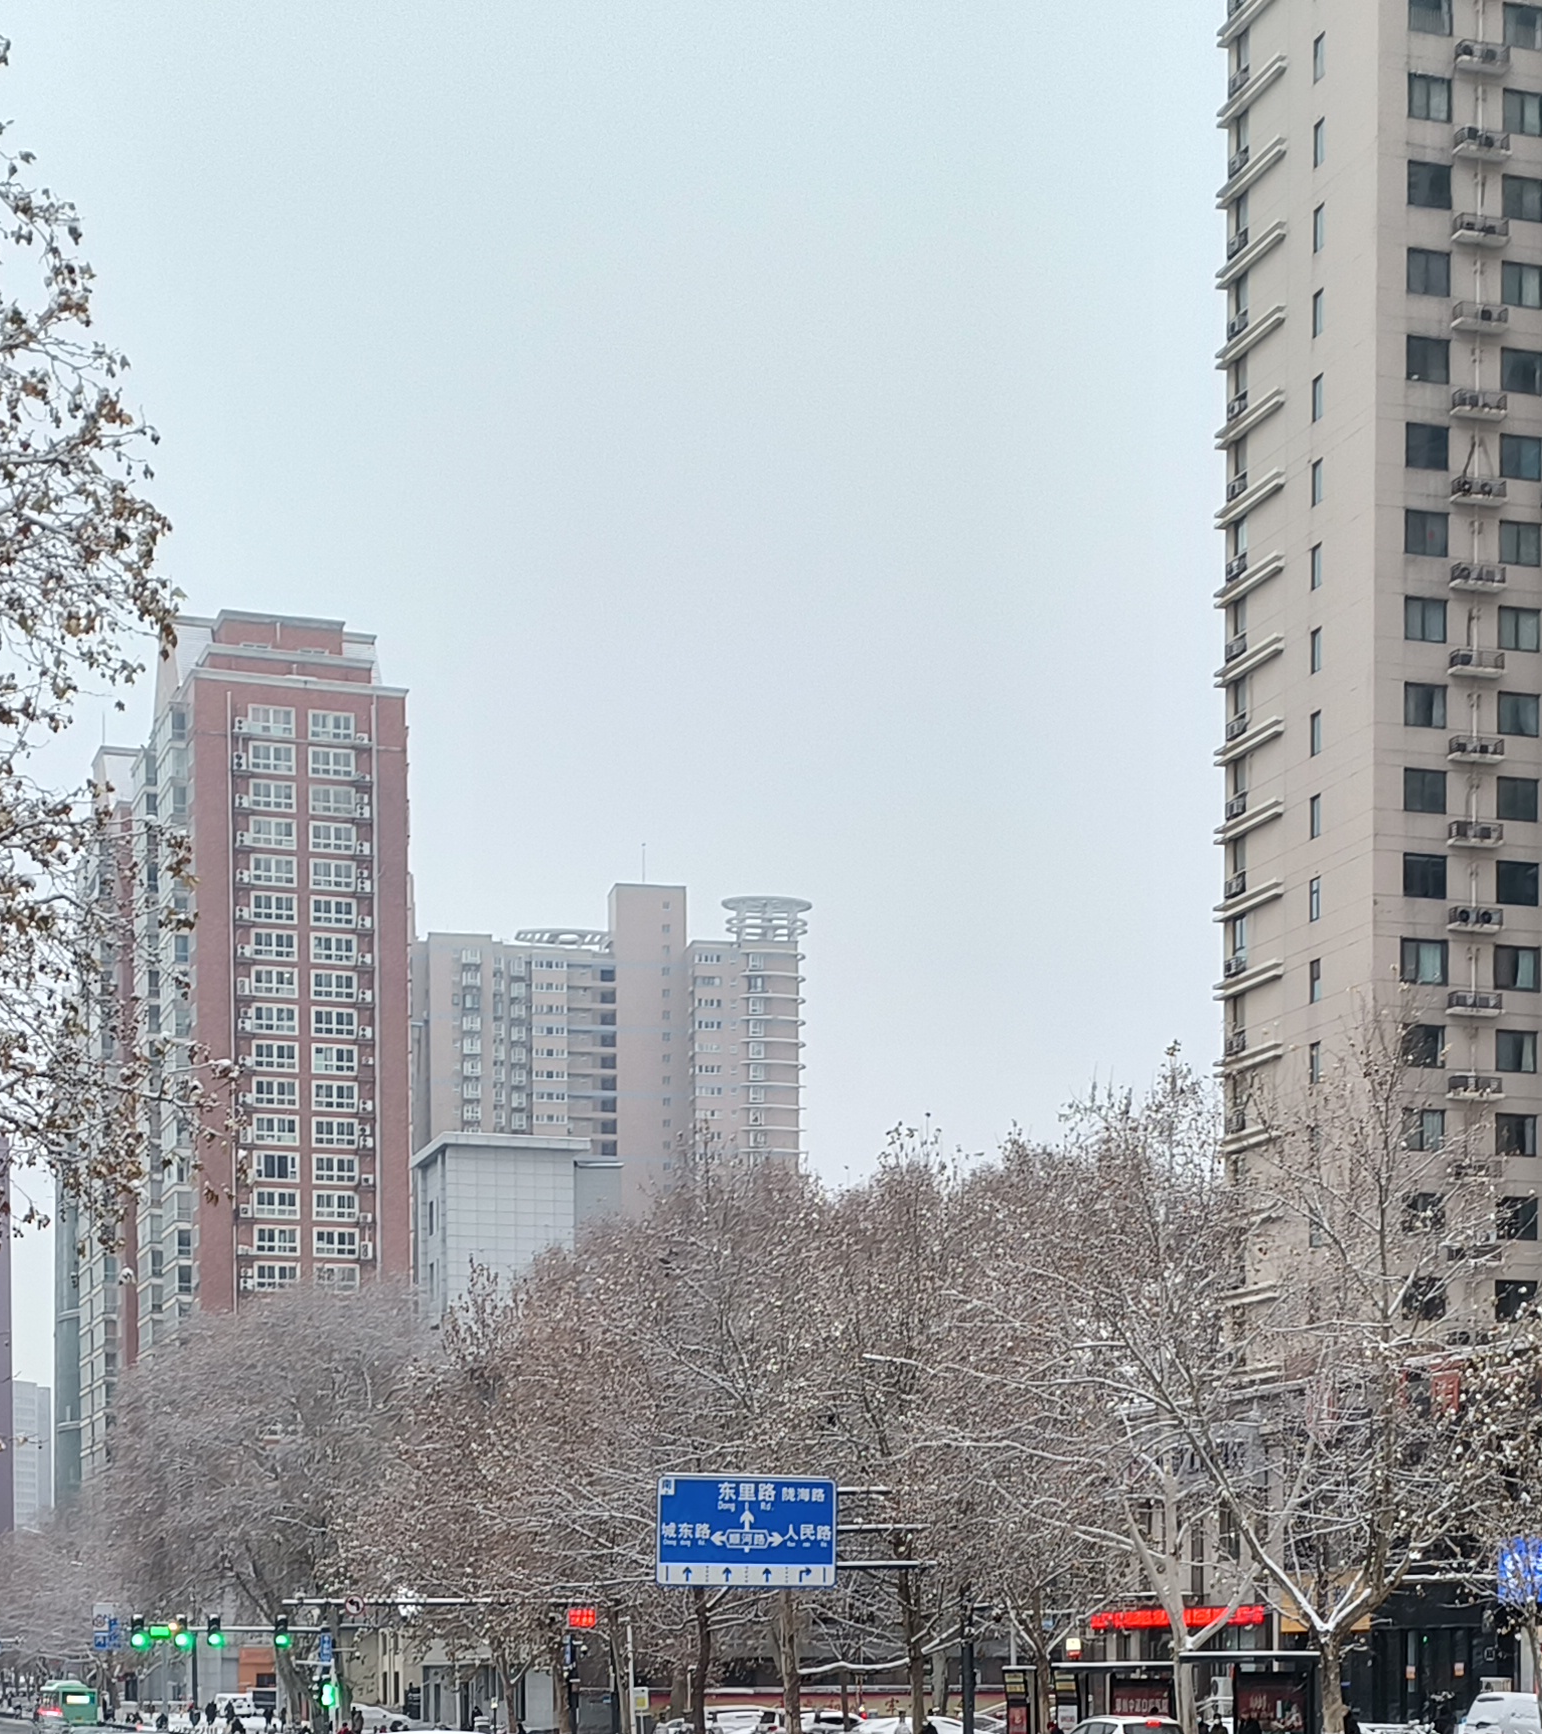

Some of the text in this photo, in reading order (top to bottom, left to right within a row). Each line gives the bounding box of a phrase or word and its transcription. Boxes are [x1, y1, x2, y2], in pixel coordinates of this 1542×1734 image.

[717, 1482, 826, 1502] 东里路 陇海路
[662, 1522, 710, 1539] 城东路
[783, 1523, 832, 1541] 人民路
